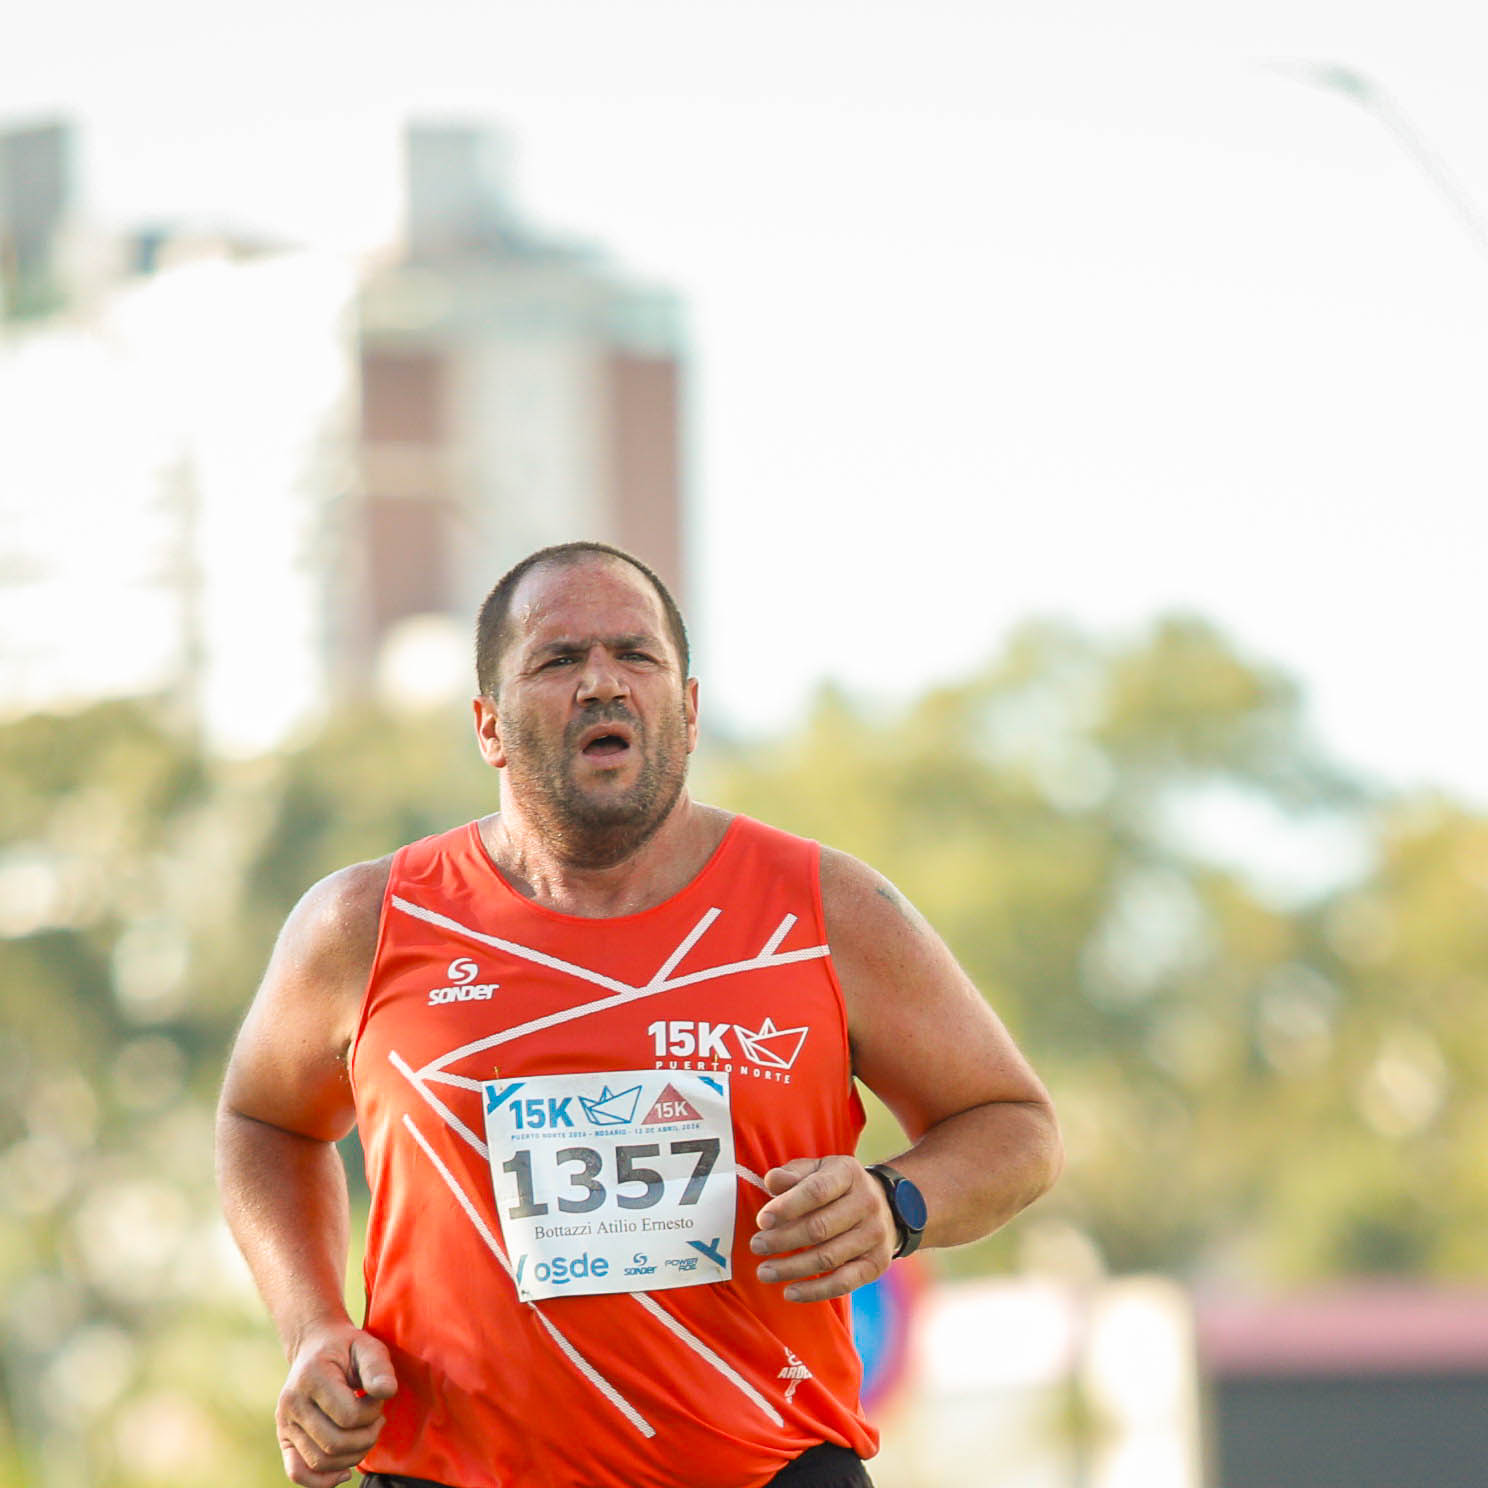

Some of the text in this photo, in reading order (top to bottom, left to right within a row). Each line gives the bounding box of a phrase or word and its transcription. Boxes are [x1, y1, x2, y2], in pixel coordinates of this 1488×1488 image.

[647, 1020, 732, 1060] 15K
[655, 1060, 793, 1084] PUERTO NORTE
[509, 1097, 575, 1130] 15K
[654, 1100, 690, 1119] 15K
[502, 1139, 721, 1221] 1357
[534, 1217, 694, 1240] Bottazzi Atilio Ernesto
[534, 1252, 609, 1284] osde
